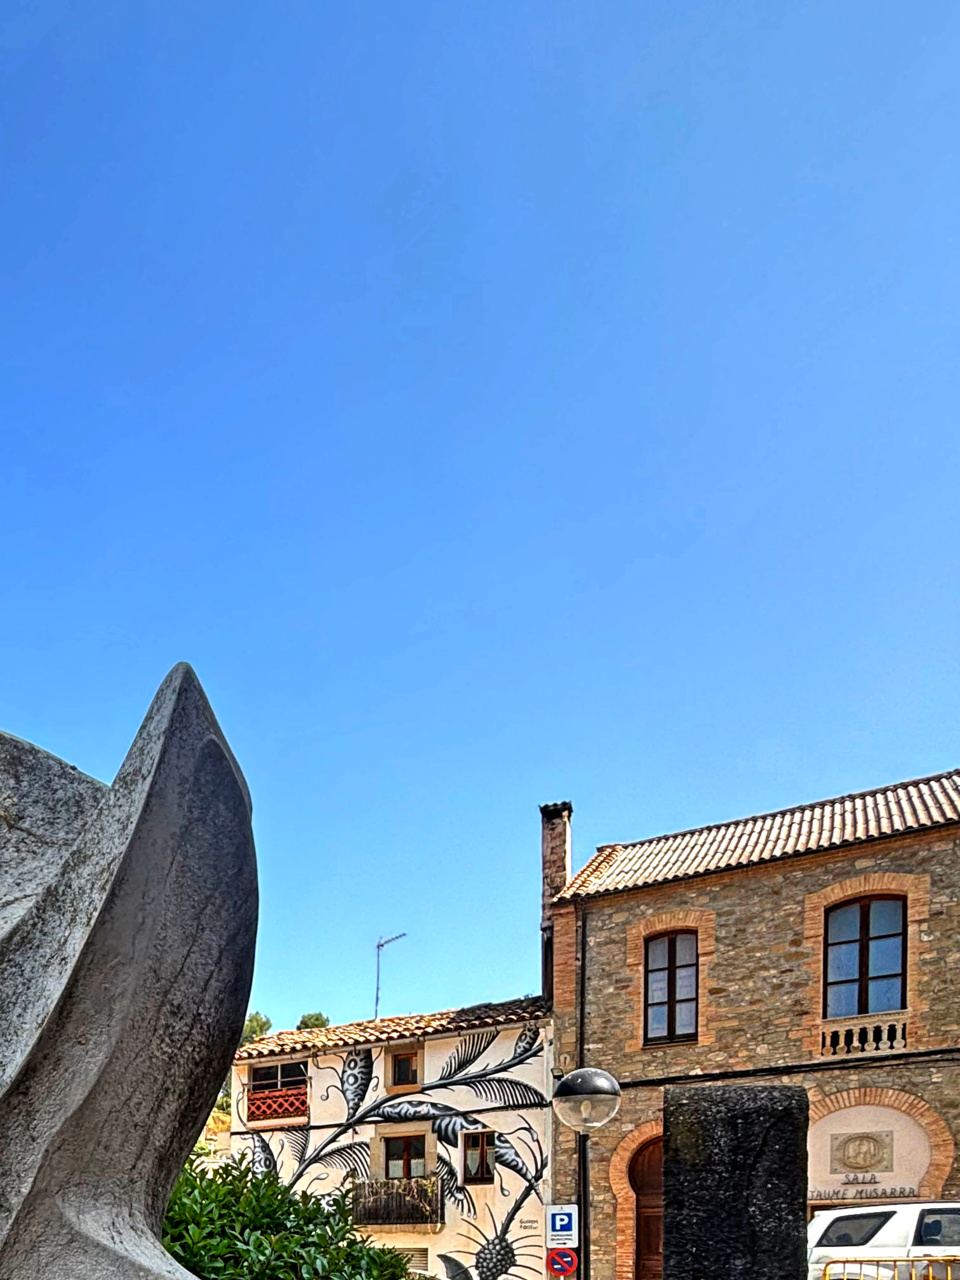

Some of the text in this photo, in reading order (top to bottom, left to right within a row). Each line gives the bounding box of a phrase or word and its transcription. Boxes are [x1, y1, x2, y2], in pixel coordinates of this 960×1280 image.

[843, 1173, 877, 1184] SALA
[809, 1188, 848, 1200] JAUME
[555, 1215, 569, 1230] P
